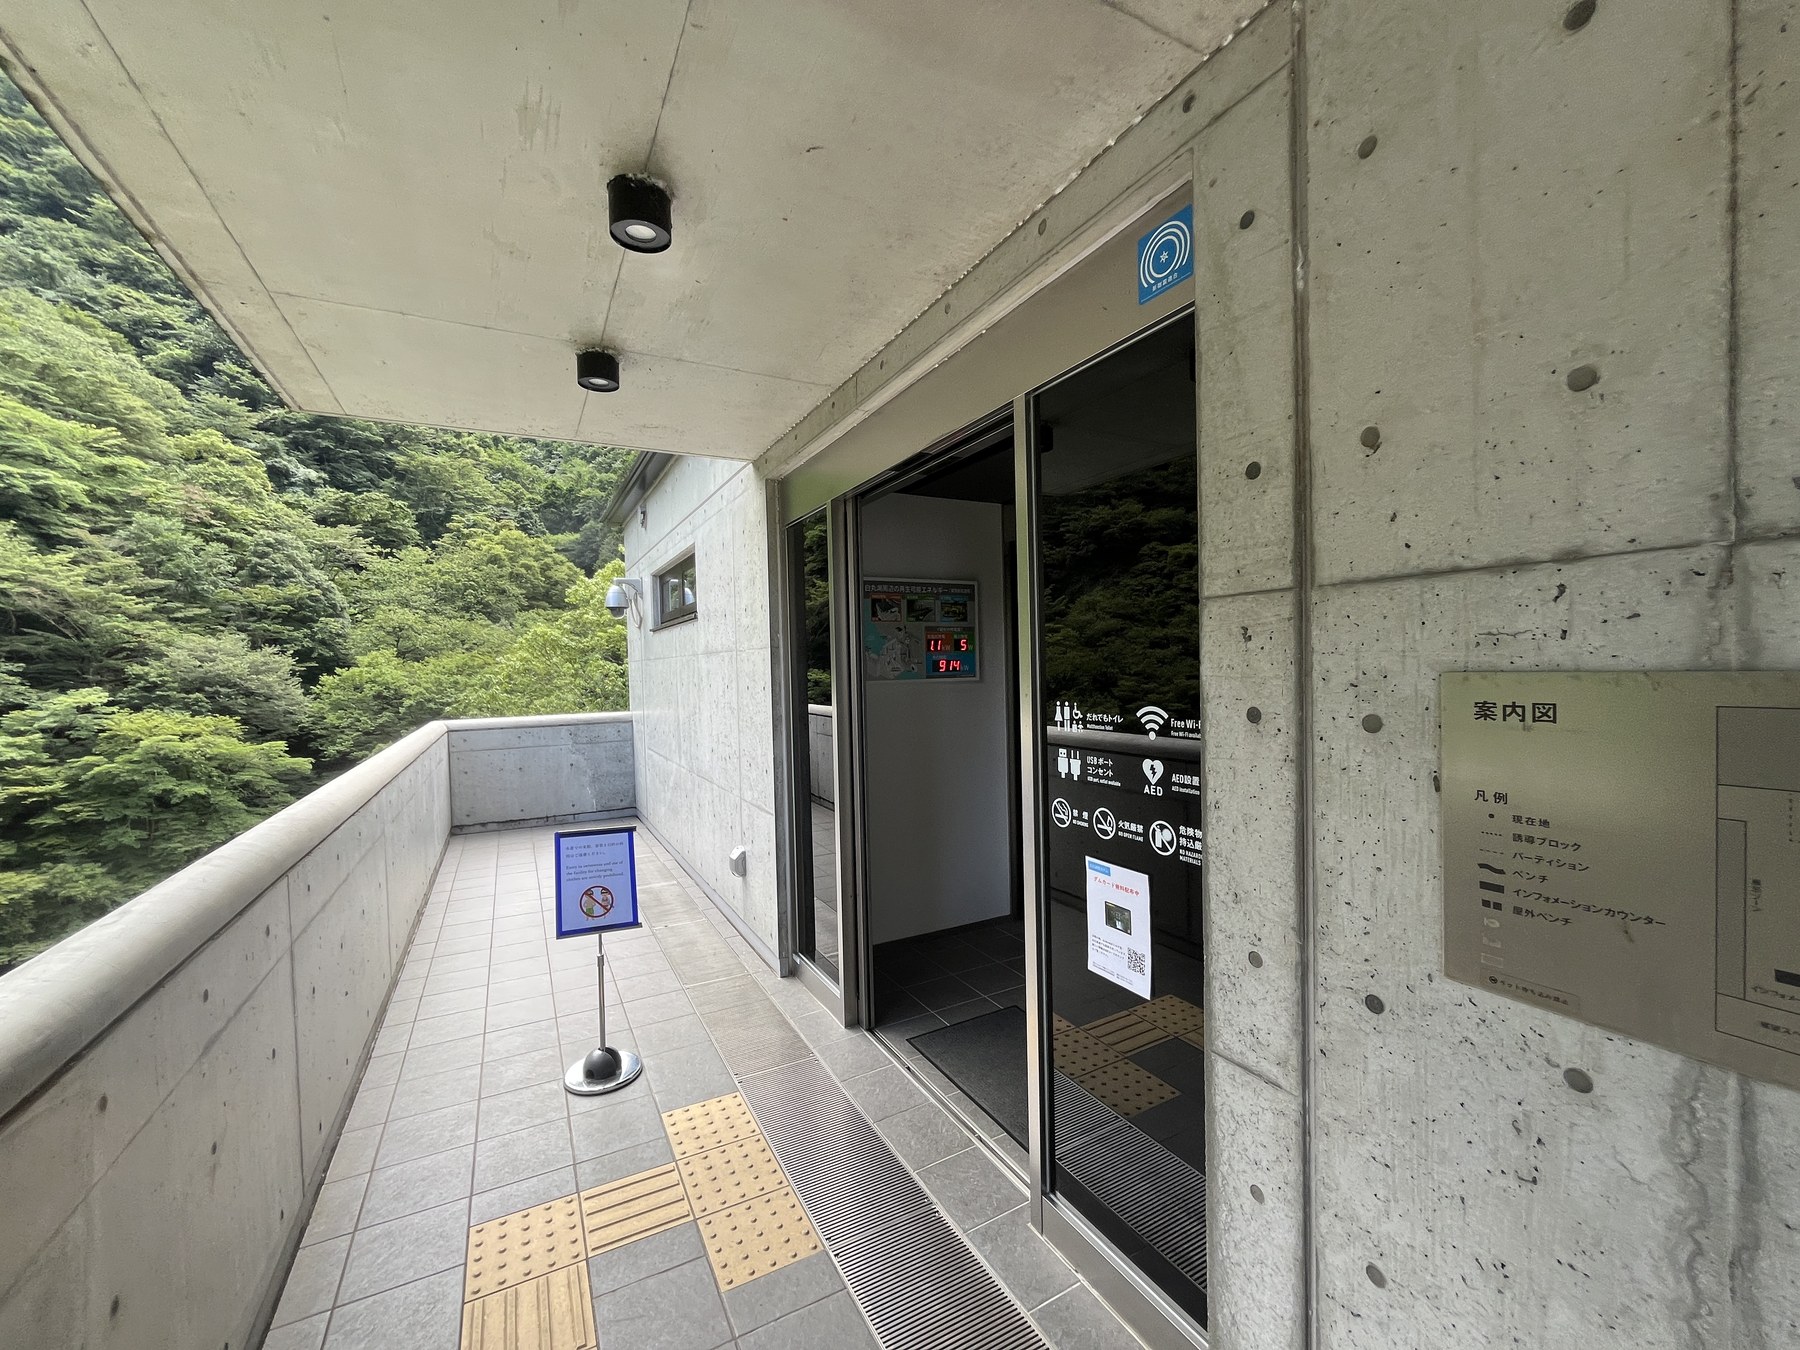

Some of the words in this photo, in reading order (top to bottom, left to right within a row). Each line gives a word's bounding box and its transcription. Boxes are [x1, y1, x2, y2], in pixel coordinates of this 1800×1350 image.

[960, 639, 967, 651] 5
[1086, 712, 1124, 723] だれでもトイレ
[1474, 701, 1558, 724] 案内図
[1170, 718, 1185, 729] Free
[1086, 755, 1098, 765] USB
[1086, 766, 1114, 777] コンセント
[1143, 784, 1164, 797] AED
[1474, 789, 1509, 805] 凡例
[1511, 814, 1551, 829] 現在地
[1179, 825, 1203, 839] 危険物
[1512, 832, 1582, 853] 誘導ブロック
[1512, 852, 1590, 873] パーティション
[1512, 869, 1550, 885] ベンチ
[1512, 888, 1667, 927] インフォメーションカウンター
[1512, 905, 1575, 927] 屋外ベンチ
